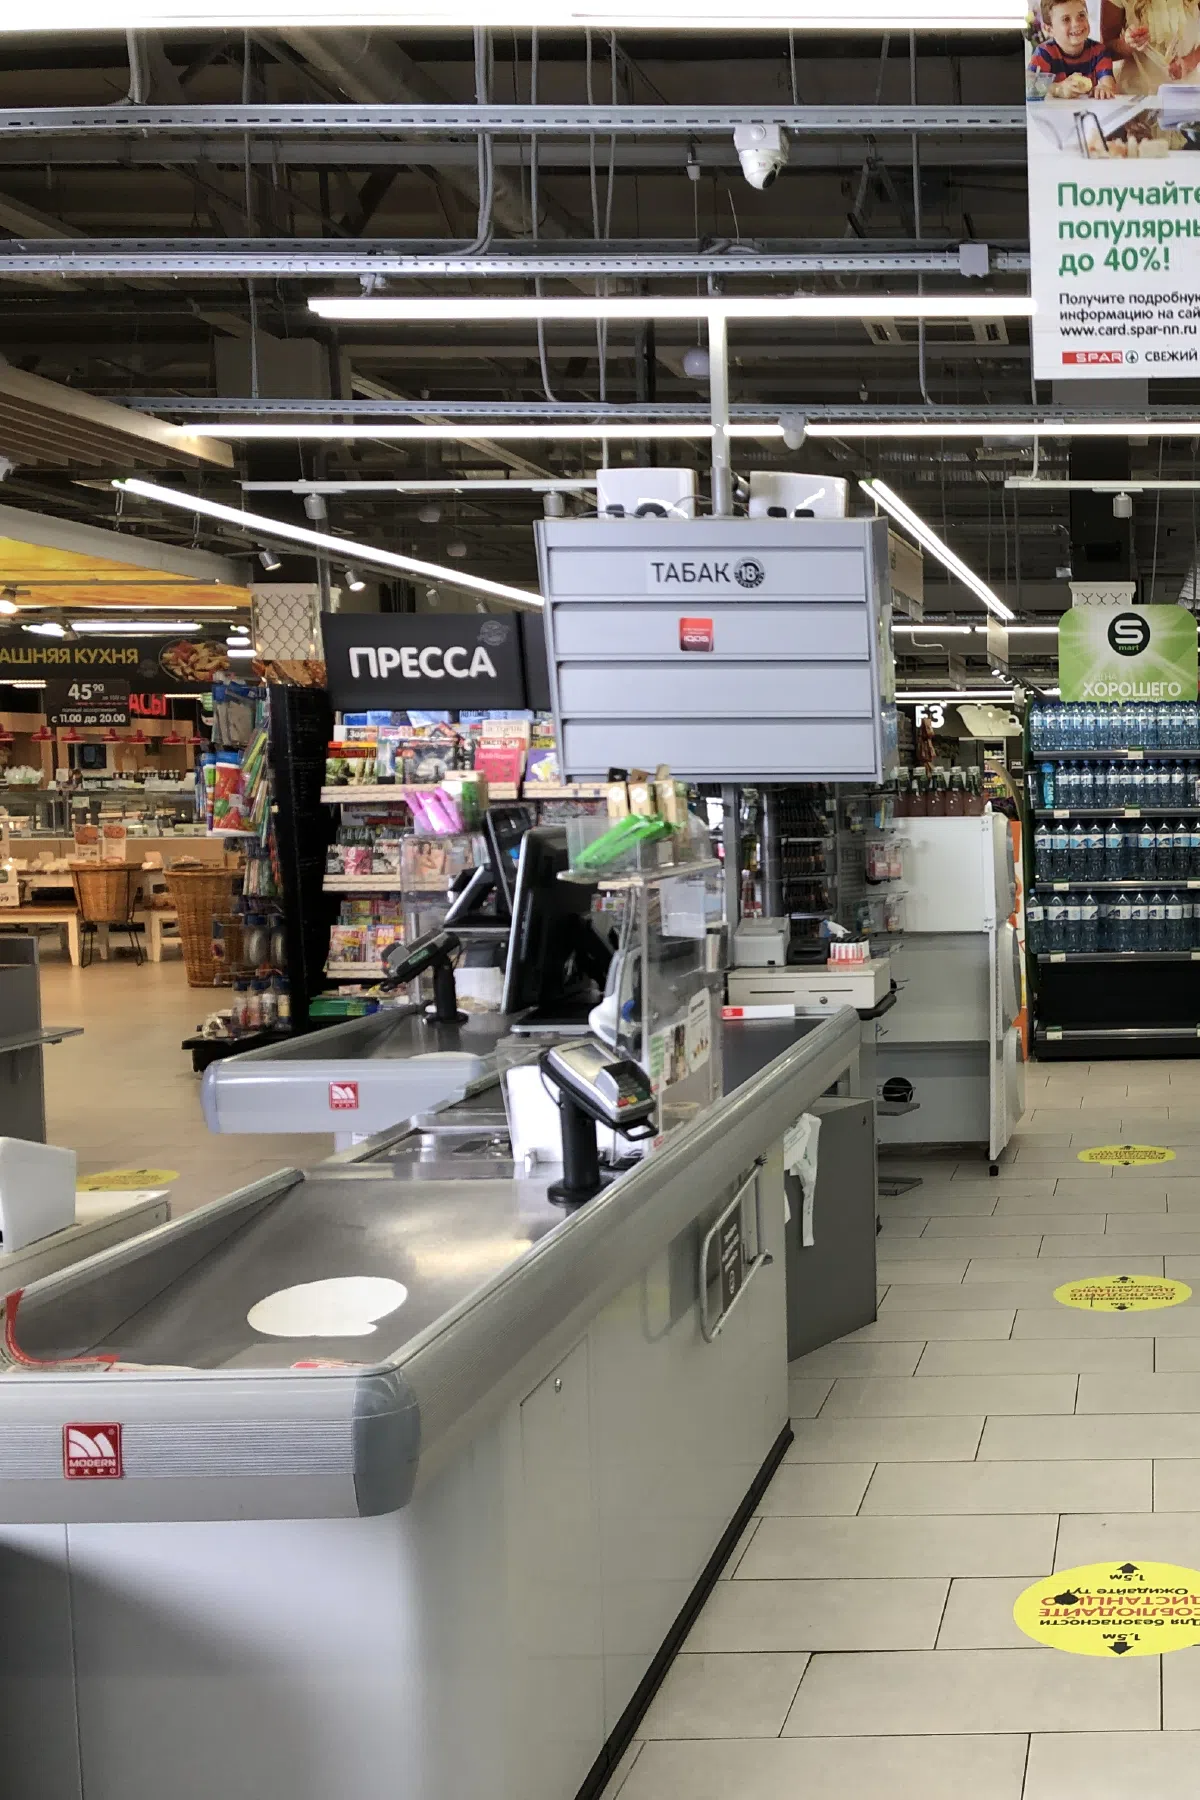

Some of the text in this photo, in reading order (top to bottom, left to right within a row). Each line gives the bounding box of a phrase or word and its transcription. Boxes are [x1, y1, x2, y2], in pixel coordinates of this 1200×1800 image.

[1059, 247, 1170, 276] до 40%!
[1059, 292, 1125, 307] Получите
[1059, 308, 1154, 322] информацию
[1158, 309, 1174, 320] на
[1060, 323, 1197, 338] www.card.spar-nn.ru
[1076, 353, 1122, 364] SPAR
[1145, 349, 1198, 362] СВЕЖИЙ
[650, 562, 731, 583] ТАБАК
[74, 648, 139, 664] КУХНЯ
[349, 646, 498, 678] ПРЕССА
[1082, 681, 1182, 697] ХОРОШЕГО
[60, 713, 82, 723] 11.00
[84, 715, 97, 724] до
[99, 713, 126, 723] 20.00
[69, 1459, 116, 1467] MODERN
[1109, 1573, 1145, 1581] 1,5м
[1096, 1587, 1188, 1595] Ожидайте
[1102, 1633, 1141, 1641] 1,5м
